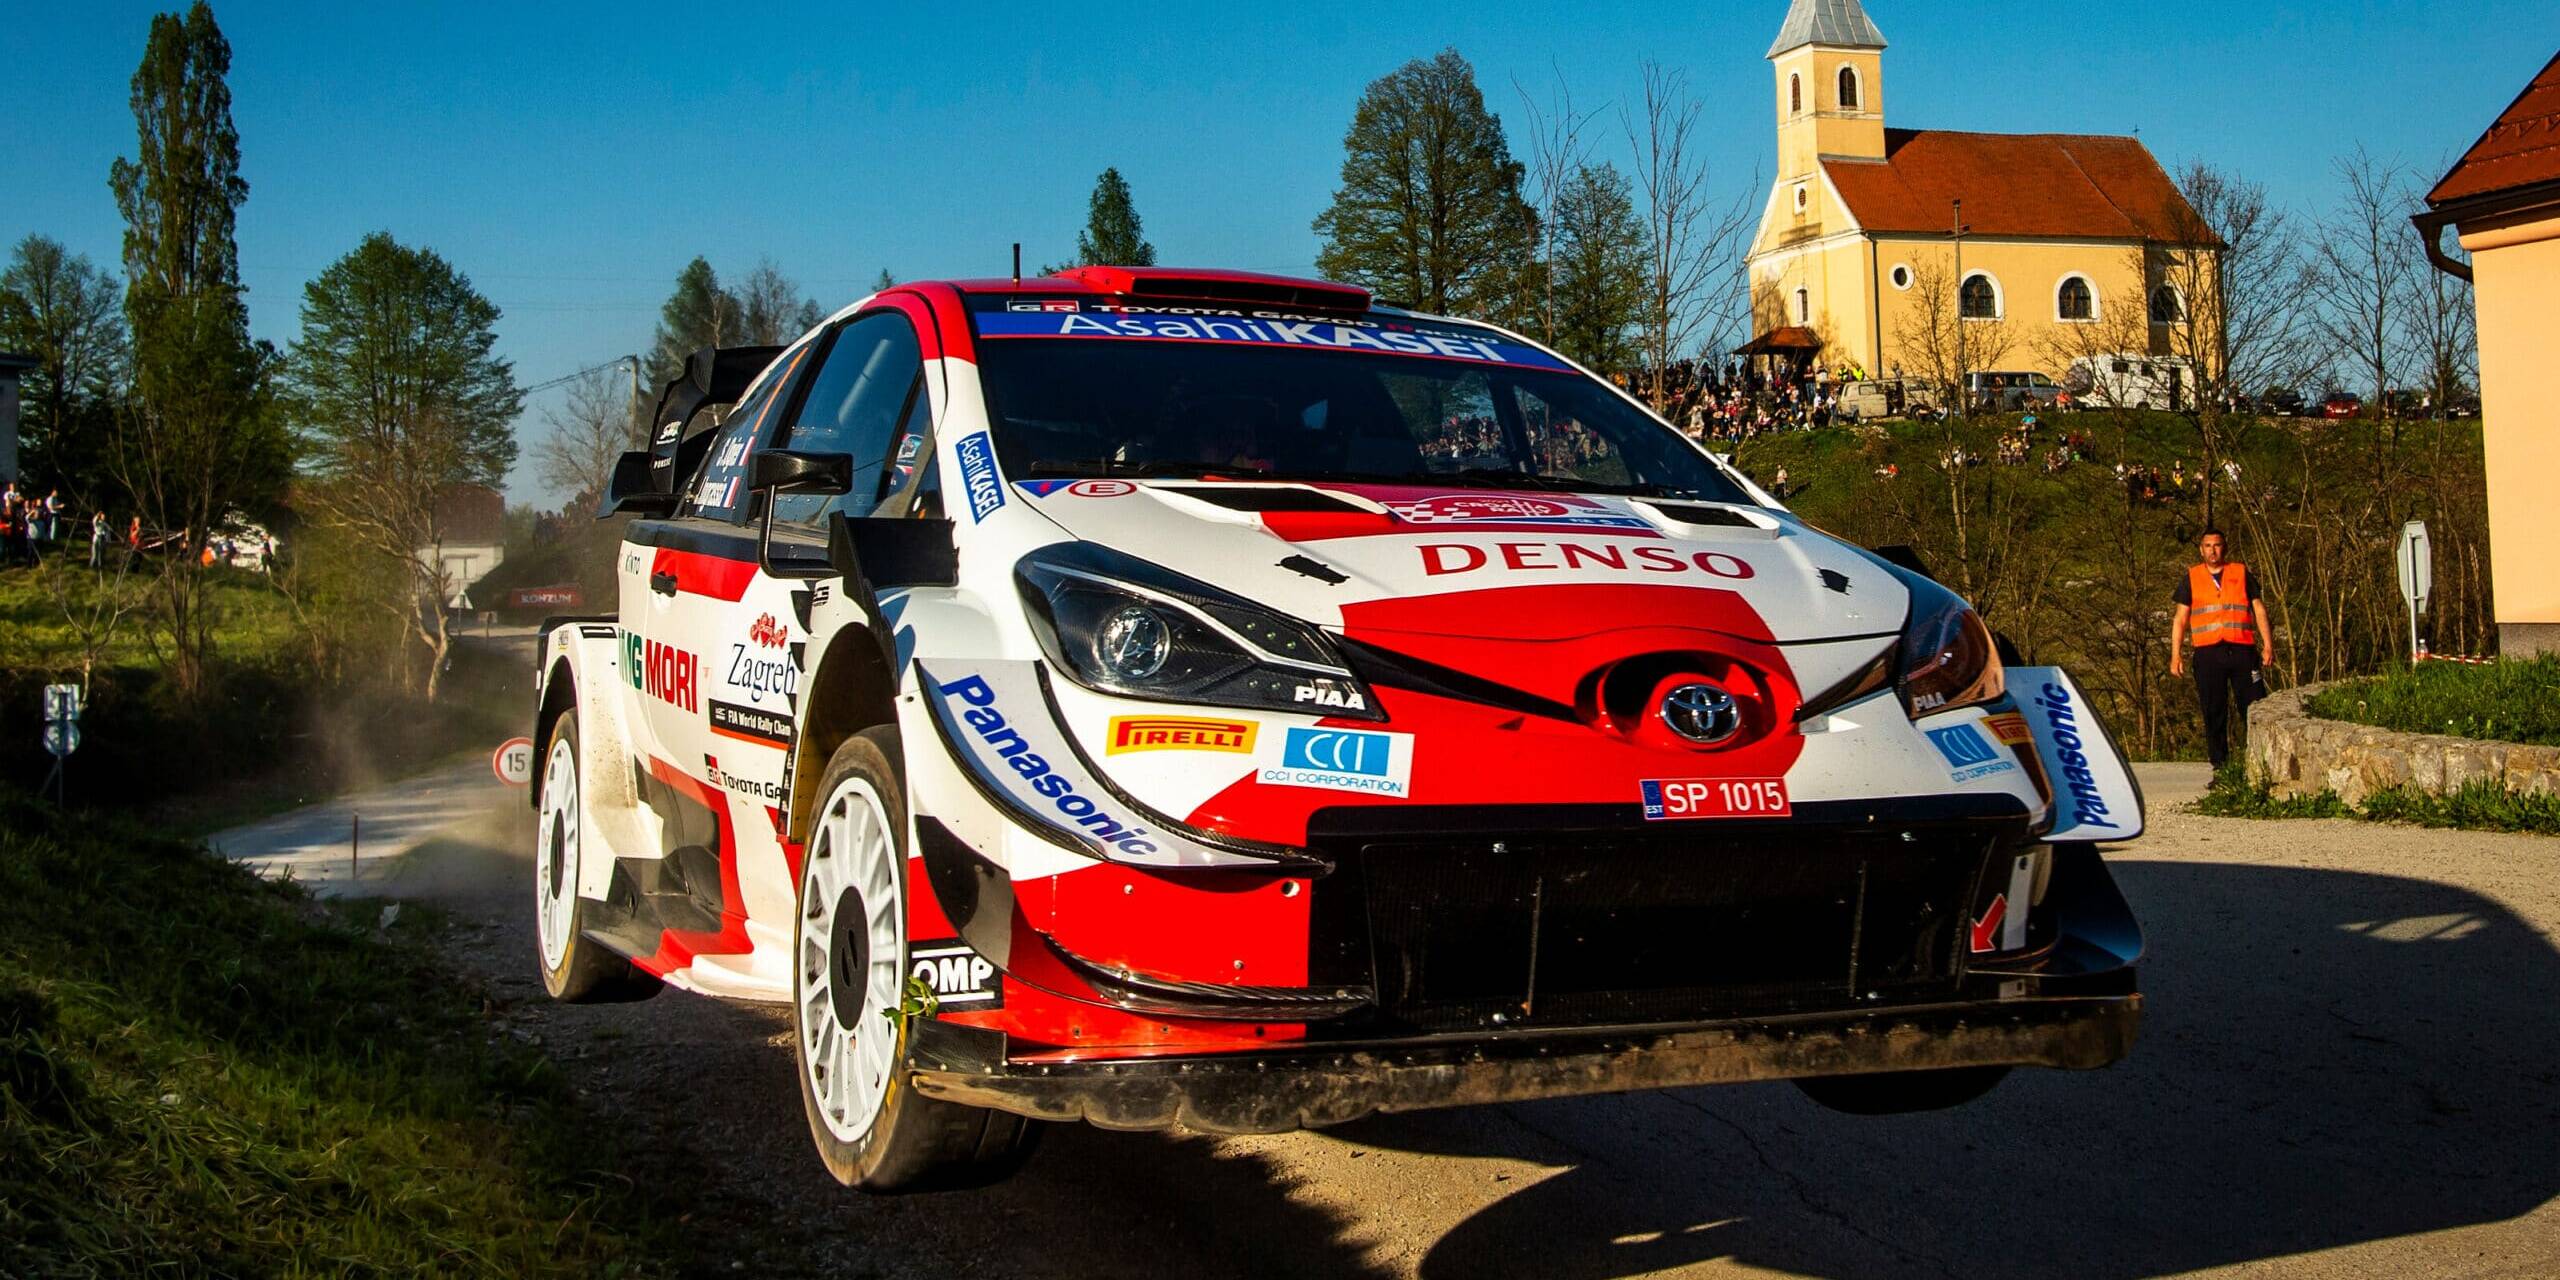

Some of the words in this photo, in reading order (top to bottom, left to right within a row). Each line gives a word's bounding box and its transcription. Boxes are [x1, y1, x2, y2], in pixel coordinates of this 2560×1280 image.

[1011, 303, 1076, 312] GR
[1091, 305, 1242, 316] TOYOTA
[1252, 311, 1379, 328] GAZOO
[1060, 314, 1507, 362] AsahiKASEI
[959, 436, 1000, 518] AsahiKASEI
[1416, 543, 1755, 580] DENSO
[646, 639, 698, 714] MORI
[727, 643, 796, 702] Zagreb
[1294, 686, 1366, 710] PIAA
[1913, 691, 1947, 711] PIAA
[728, 710, 739, 724] FIA
[739, 712, 757, 729] World
[1116, 721, 1248, 747] PIRELLI
[508, 753, 526, 772] 15
[938, 674, 1158, 855] Panasonic
[1305, 733, 1365, 771] CCI
[2034, 682, 2120, 829] Panasonic
[721, 771, 762, 796] TOYOTA
[1264, 770, 1290, 782] CCI
[1296, 772, 1403, 793] CORPORATION
[1647, 805, 1663, 814] EST
[1665, 783, 1709, 813] SP
[1718, 782, 1784, 811] 1015
[912, 956, 994, 993] OMP
